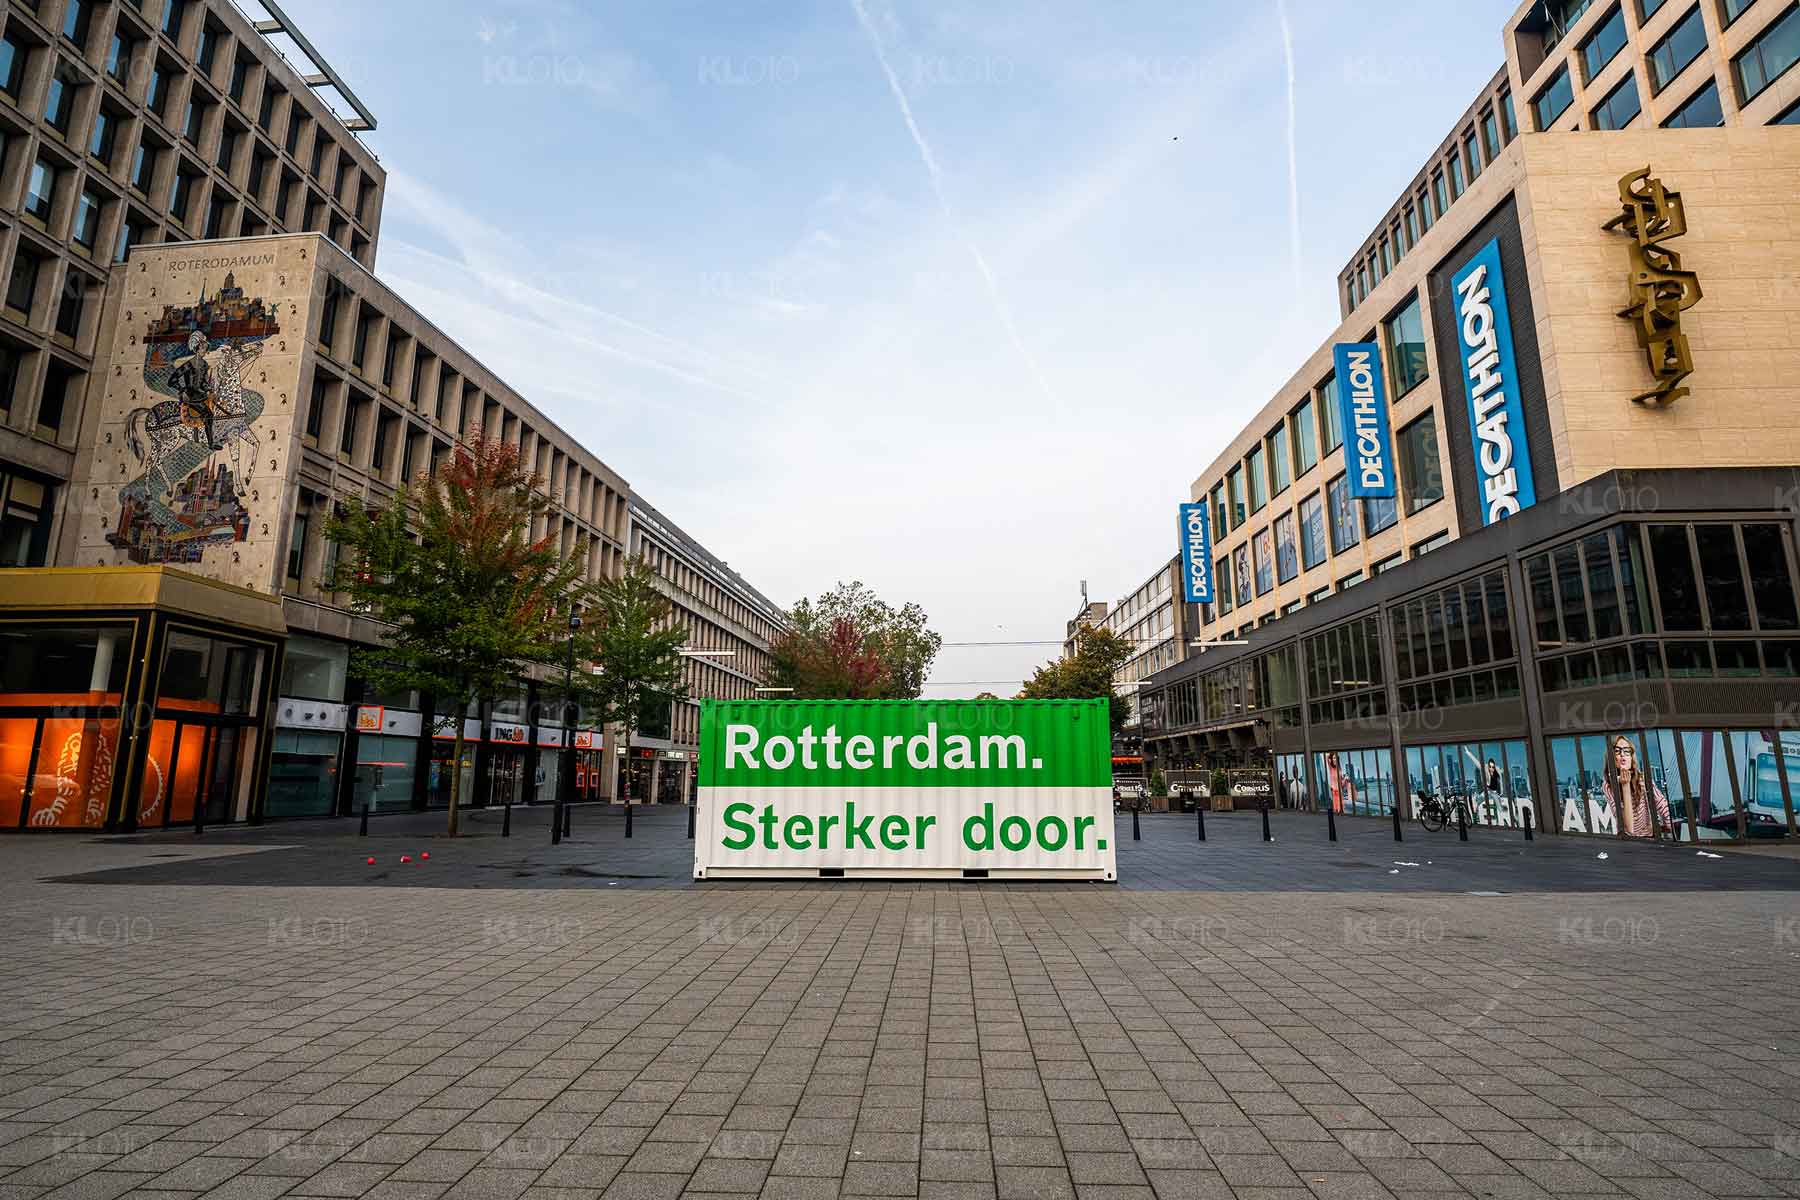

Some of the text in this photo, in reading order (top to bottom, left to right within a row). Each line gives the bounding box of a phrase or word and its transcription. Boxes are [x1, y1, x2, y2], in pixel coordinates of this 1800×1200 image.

[168, 254, 275, 271] ROTERODAMUM
[1347, 352, 1385, 488] DECATHLON
[1187, 509, 1208, 597] DECATHLON
[494, 727, 513, 741] ING
[725, 721, 1043, 770] Rotterdam.
[721, 802, 1108, 852] Sterker door.
